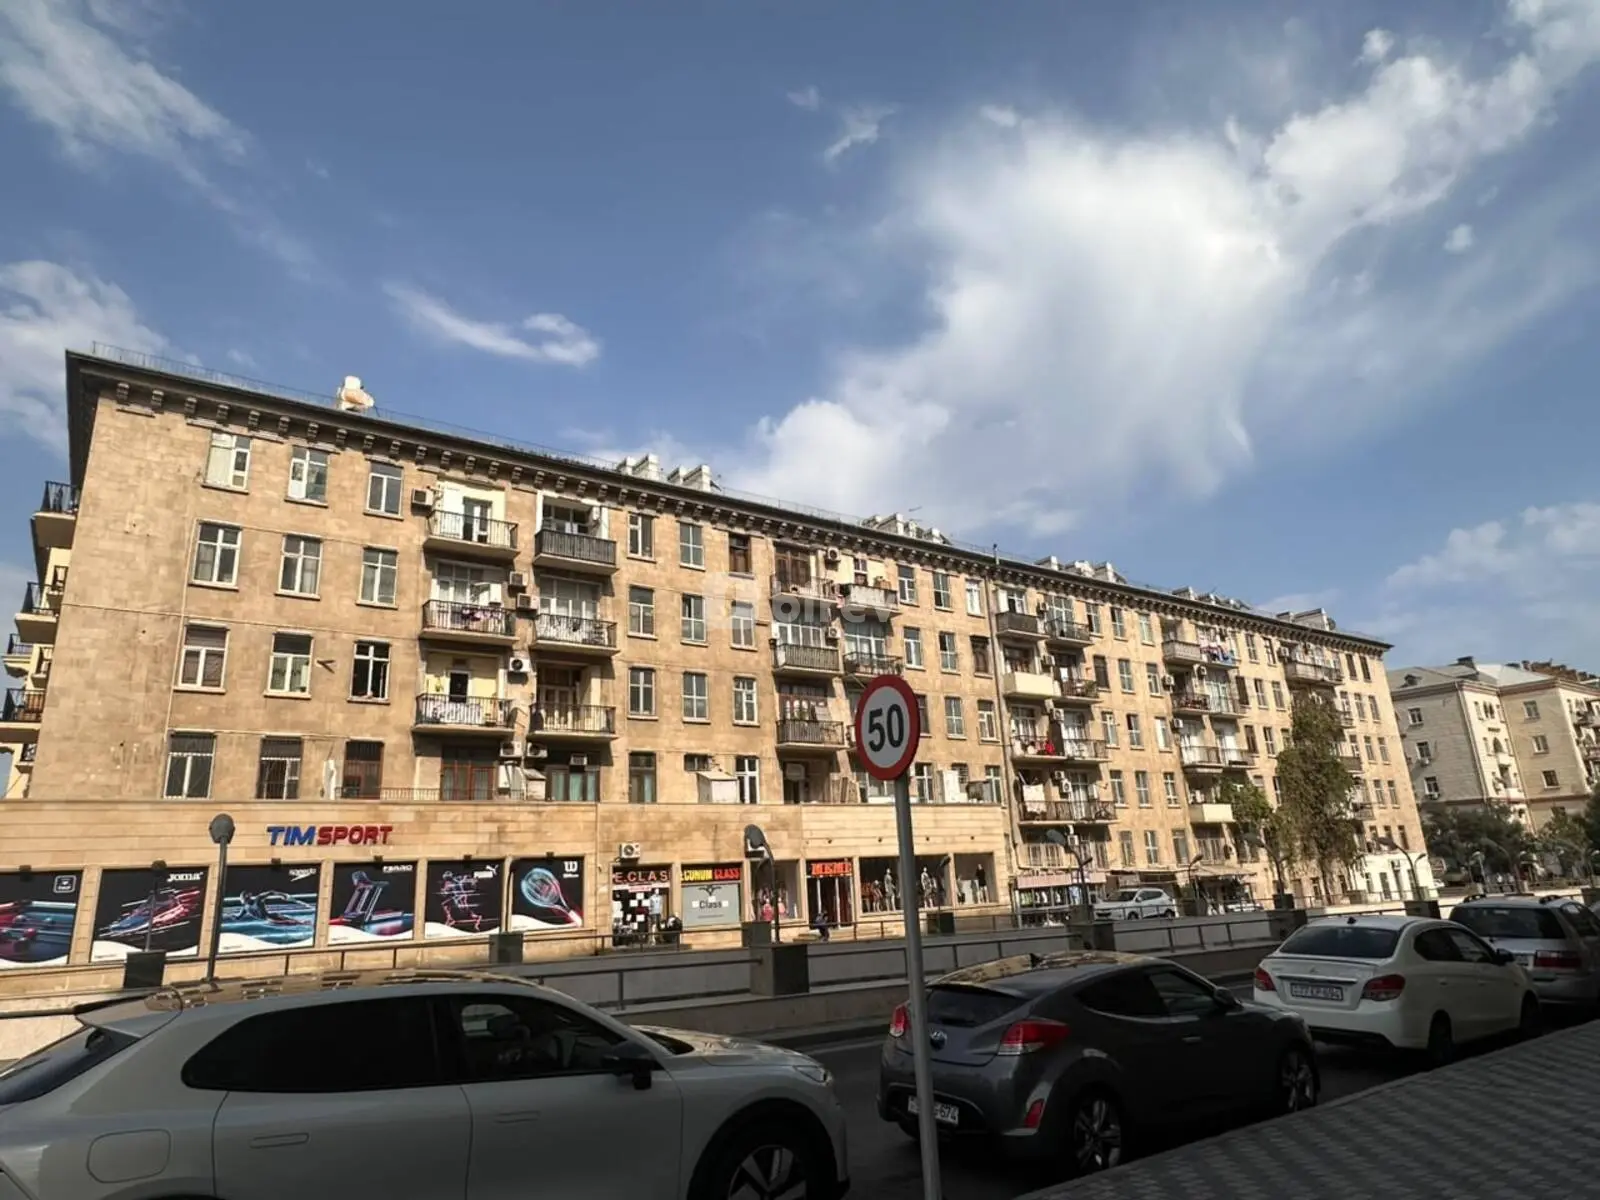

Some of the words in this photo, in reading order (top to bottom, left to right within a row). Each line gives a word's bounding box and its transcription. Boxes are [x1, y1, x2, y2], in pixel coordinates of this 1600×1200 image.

[868, 703, 905, 753] 50
[267, 826, 316, 846] TIM
[317, 825, 393, 845] SPORT
